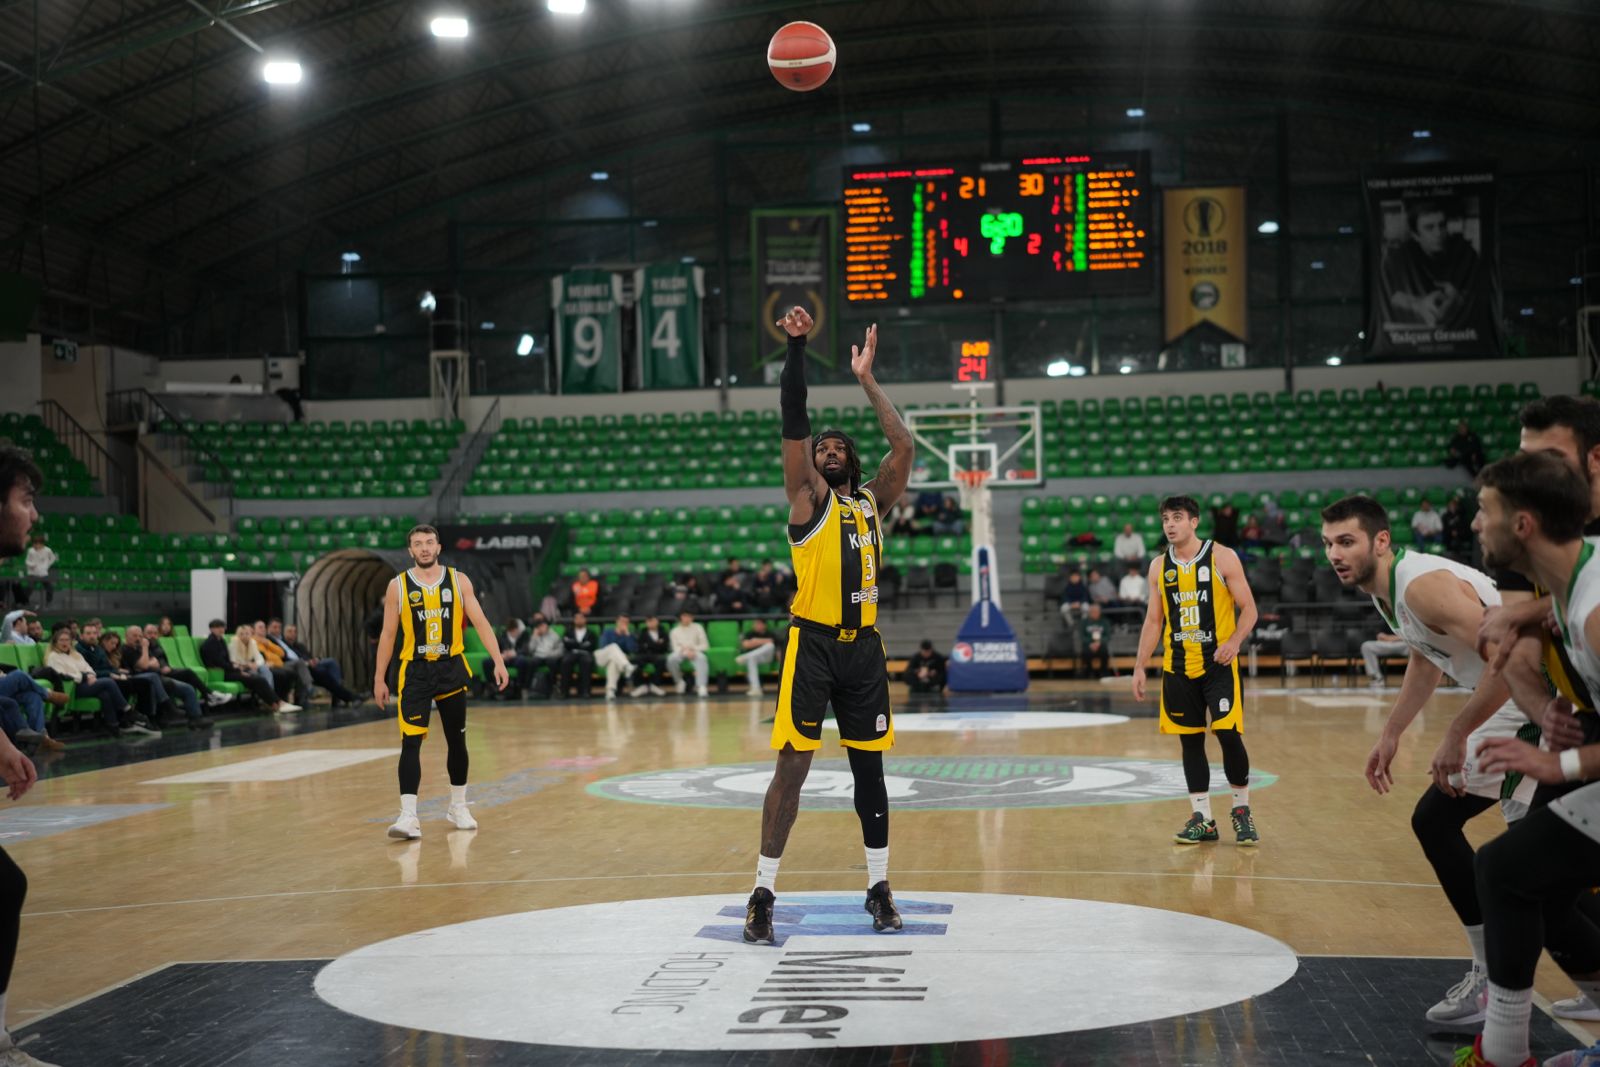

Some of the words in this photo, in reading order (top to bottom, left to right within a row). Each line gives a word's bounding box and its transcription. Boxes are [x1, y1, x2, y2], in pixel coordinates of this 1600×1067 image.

[959, 176, 986, 199] 21
[1018, 172, 1045, 197] 30
[953, 237, 968, 257] 4
[1183, 239, 1228, 255] 2018
[573, 316, 603, 368] 9
[651, 309, 682, 358] 4
[958, 357, 987, 382] 24
[865, 554, 874, 581] 3
[1172, 589, 1208, 605] KONYA
[417, 607, 450, 622] KONYA
[1178, 605, 1201, 627] 20
[429, 622, 439, 641] 2
[726, 950, 929, 1039] Miller
